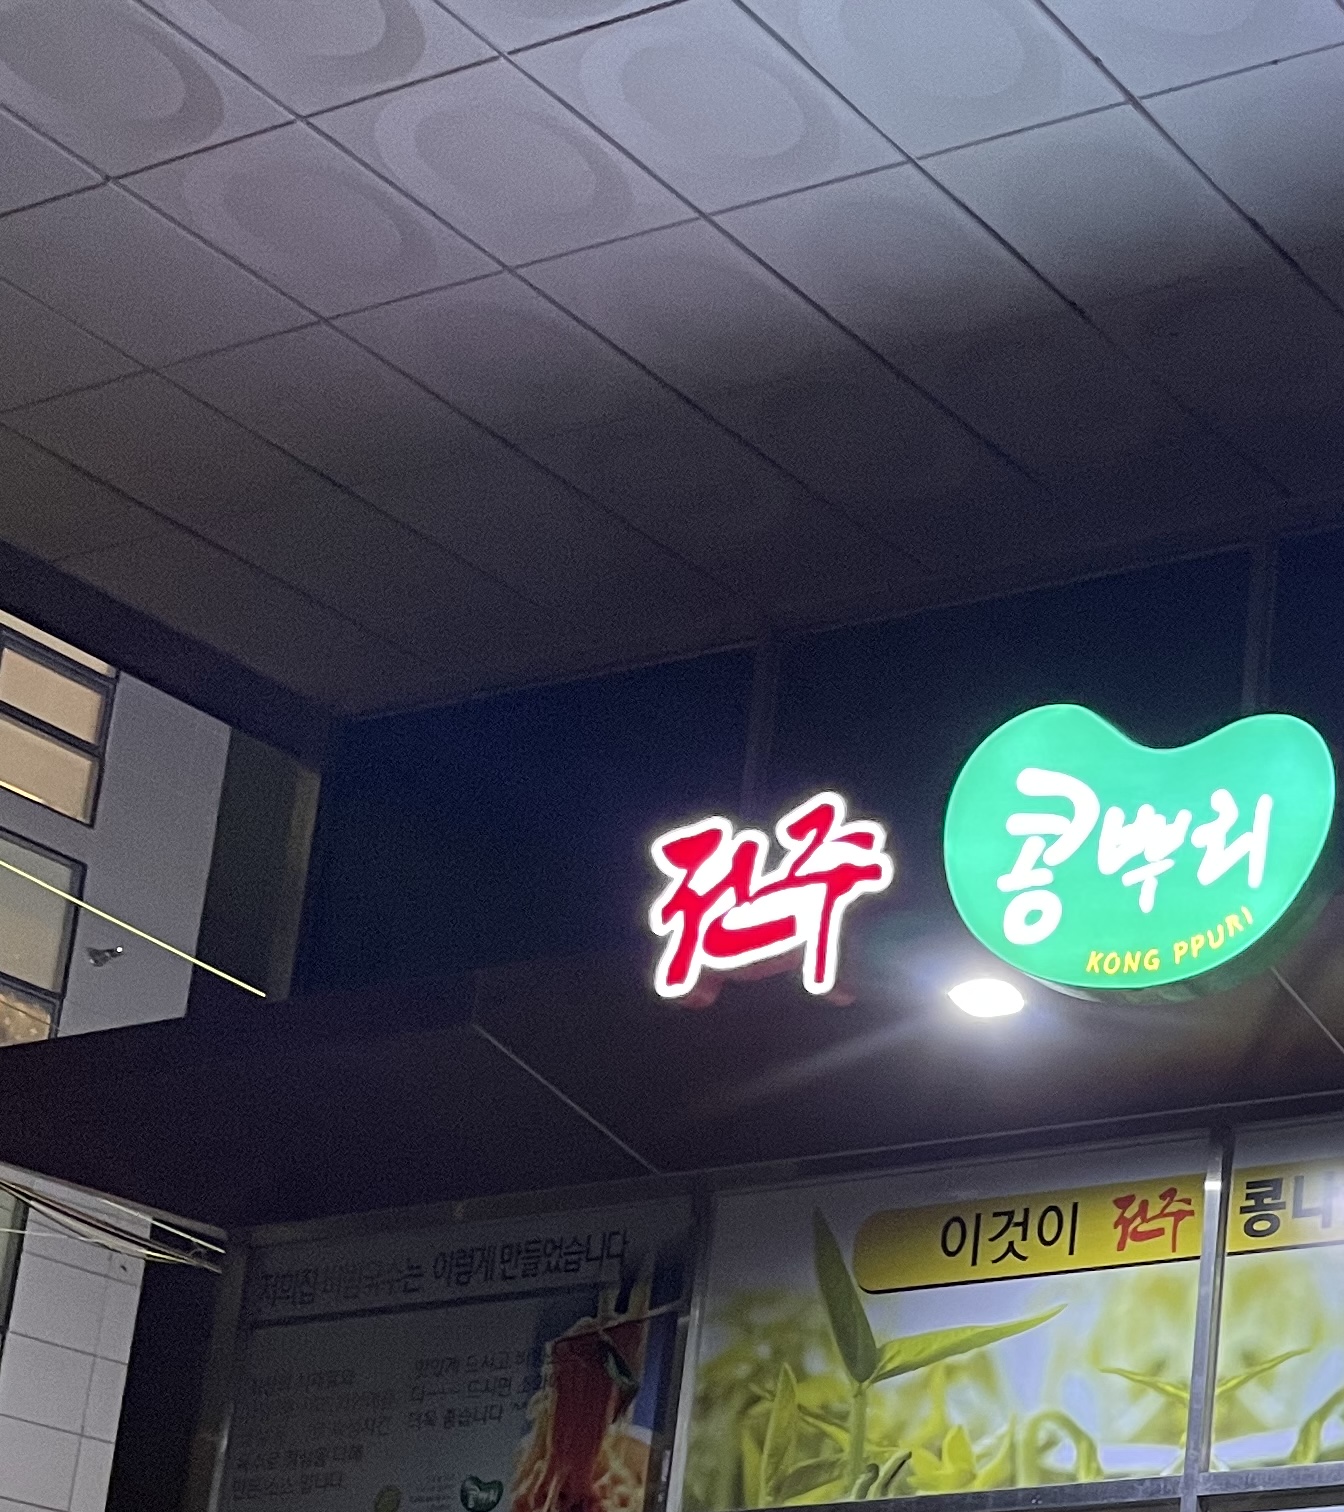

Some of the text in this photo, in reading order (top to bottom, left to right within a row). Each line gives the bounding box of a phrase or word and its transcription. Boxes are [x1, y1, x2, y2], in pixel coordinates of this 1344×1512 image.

[650, 792, 892, 998] 전주
[997, 767, 1273, 945] 콩뿌리
[1086, 905, 1254, 976] KONG PPURI
[939, 1200, 1080, 1267] 이것이
[1111, 1193, 1198, 1255] 전주
